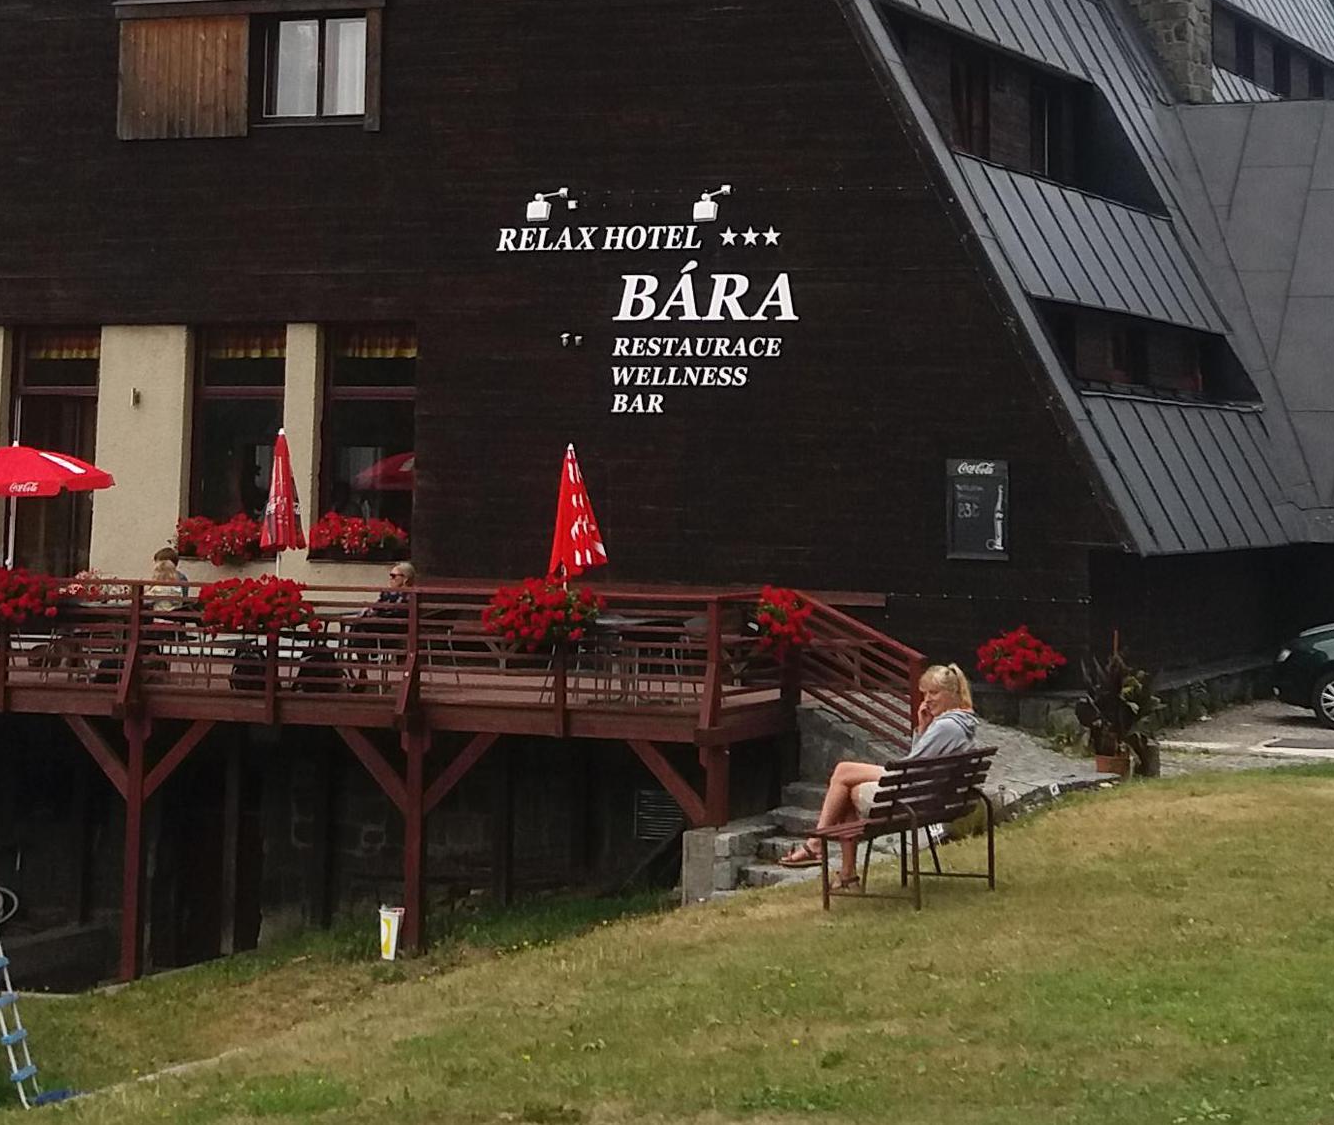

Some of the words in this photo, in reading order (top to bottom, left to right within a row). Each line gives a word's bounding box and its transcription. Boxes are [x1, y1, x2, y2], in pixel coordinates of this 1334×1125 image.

[496, 227, 598, 251] RELAX
[602, 226, 702, 251] HOTEL
[612, 260, 799, 321] BÁRA
[612, 337, 782, 357] RESTAURACE
[612, 367, 748, 387] WELLNESS
[611, 394, 664, 413] BAR
